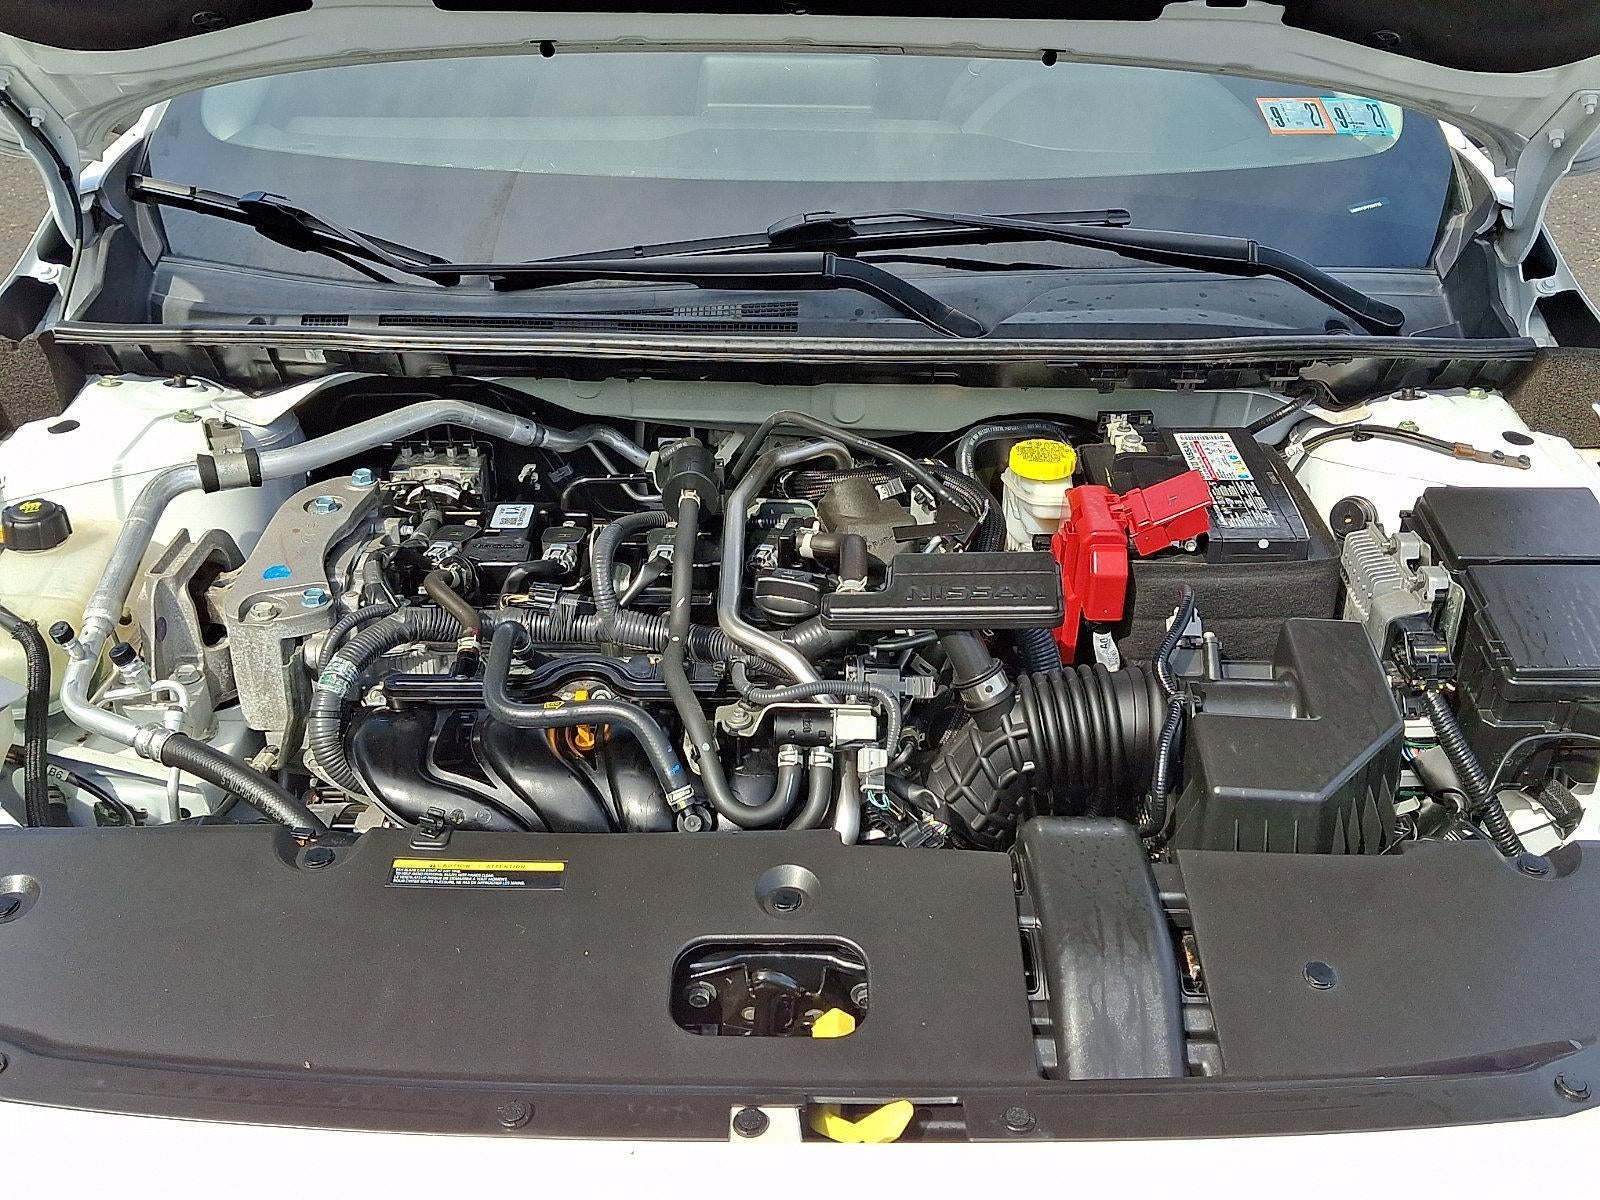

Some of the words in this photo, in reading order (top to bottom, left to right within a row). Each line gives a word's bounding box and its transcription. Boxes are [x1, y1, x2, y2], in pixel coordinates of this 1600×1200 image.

[1269, 106, 1286, 128] 9
[1303, 102, 1325, 129] 27
[1333, 107, 1349, 129] 9
[1365, 103, 1387, 129] 27
[906, 586, 1047, 601] NISSAN
[49, 766, 64, 779] B6
